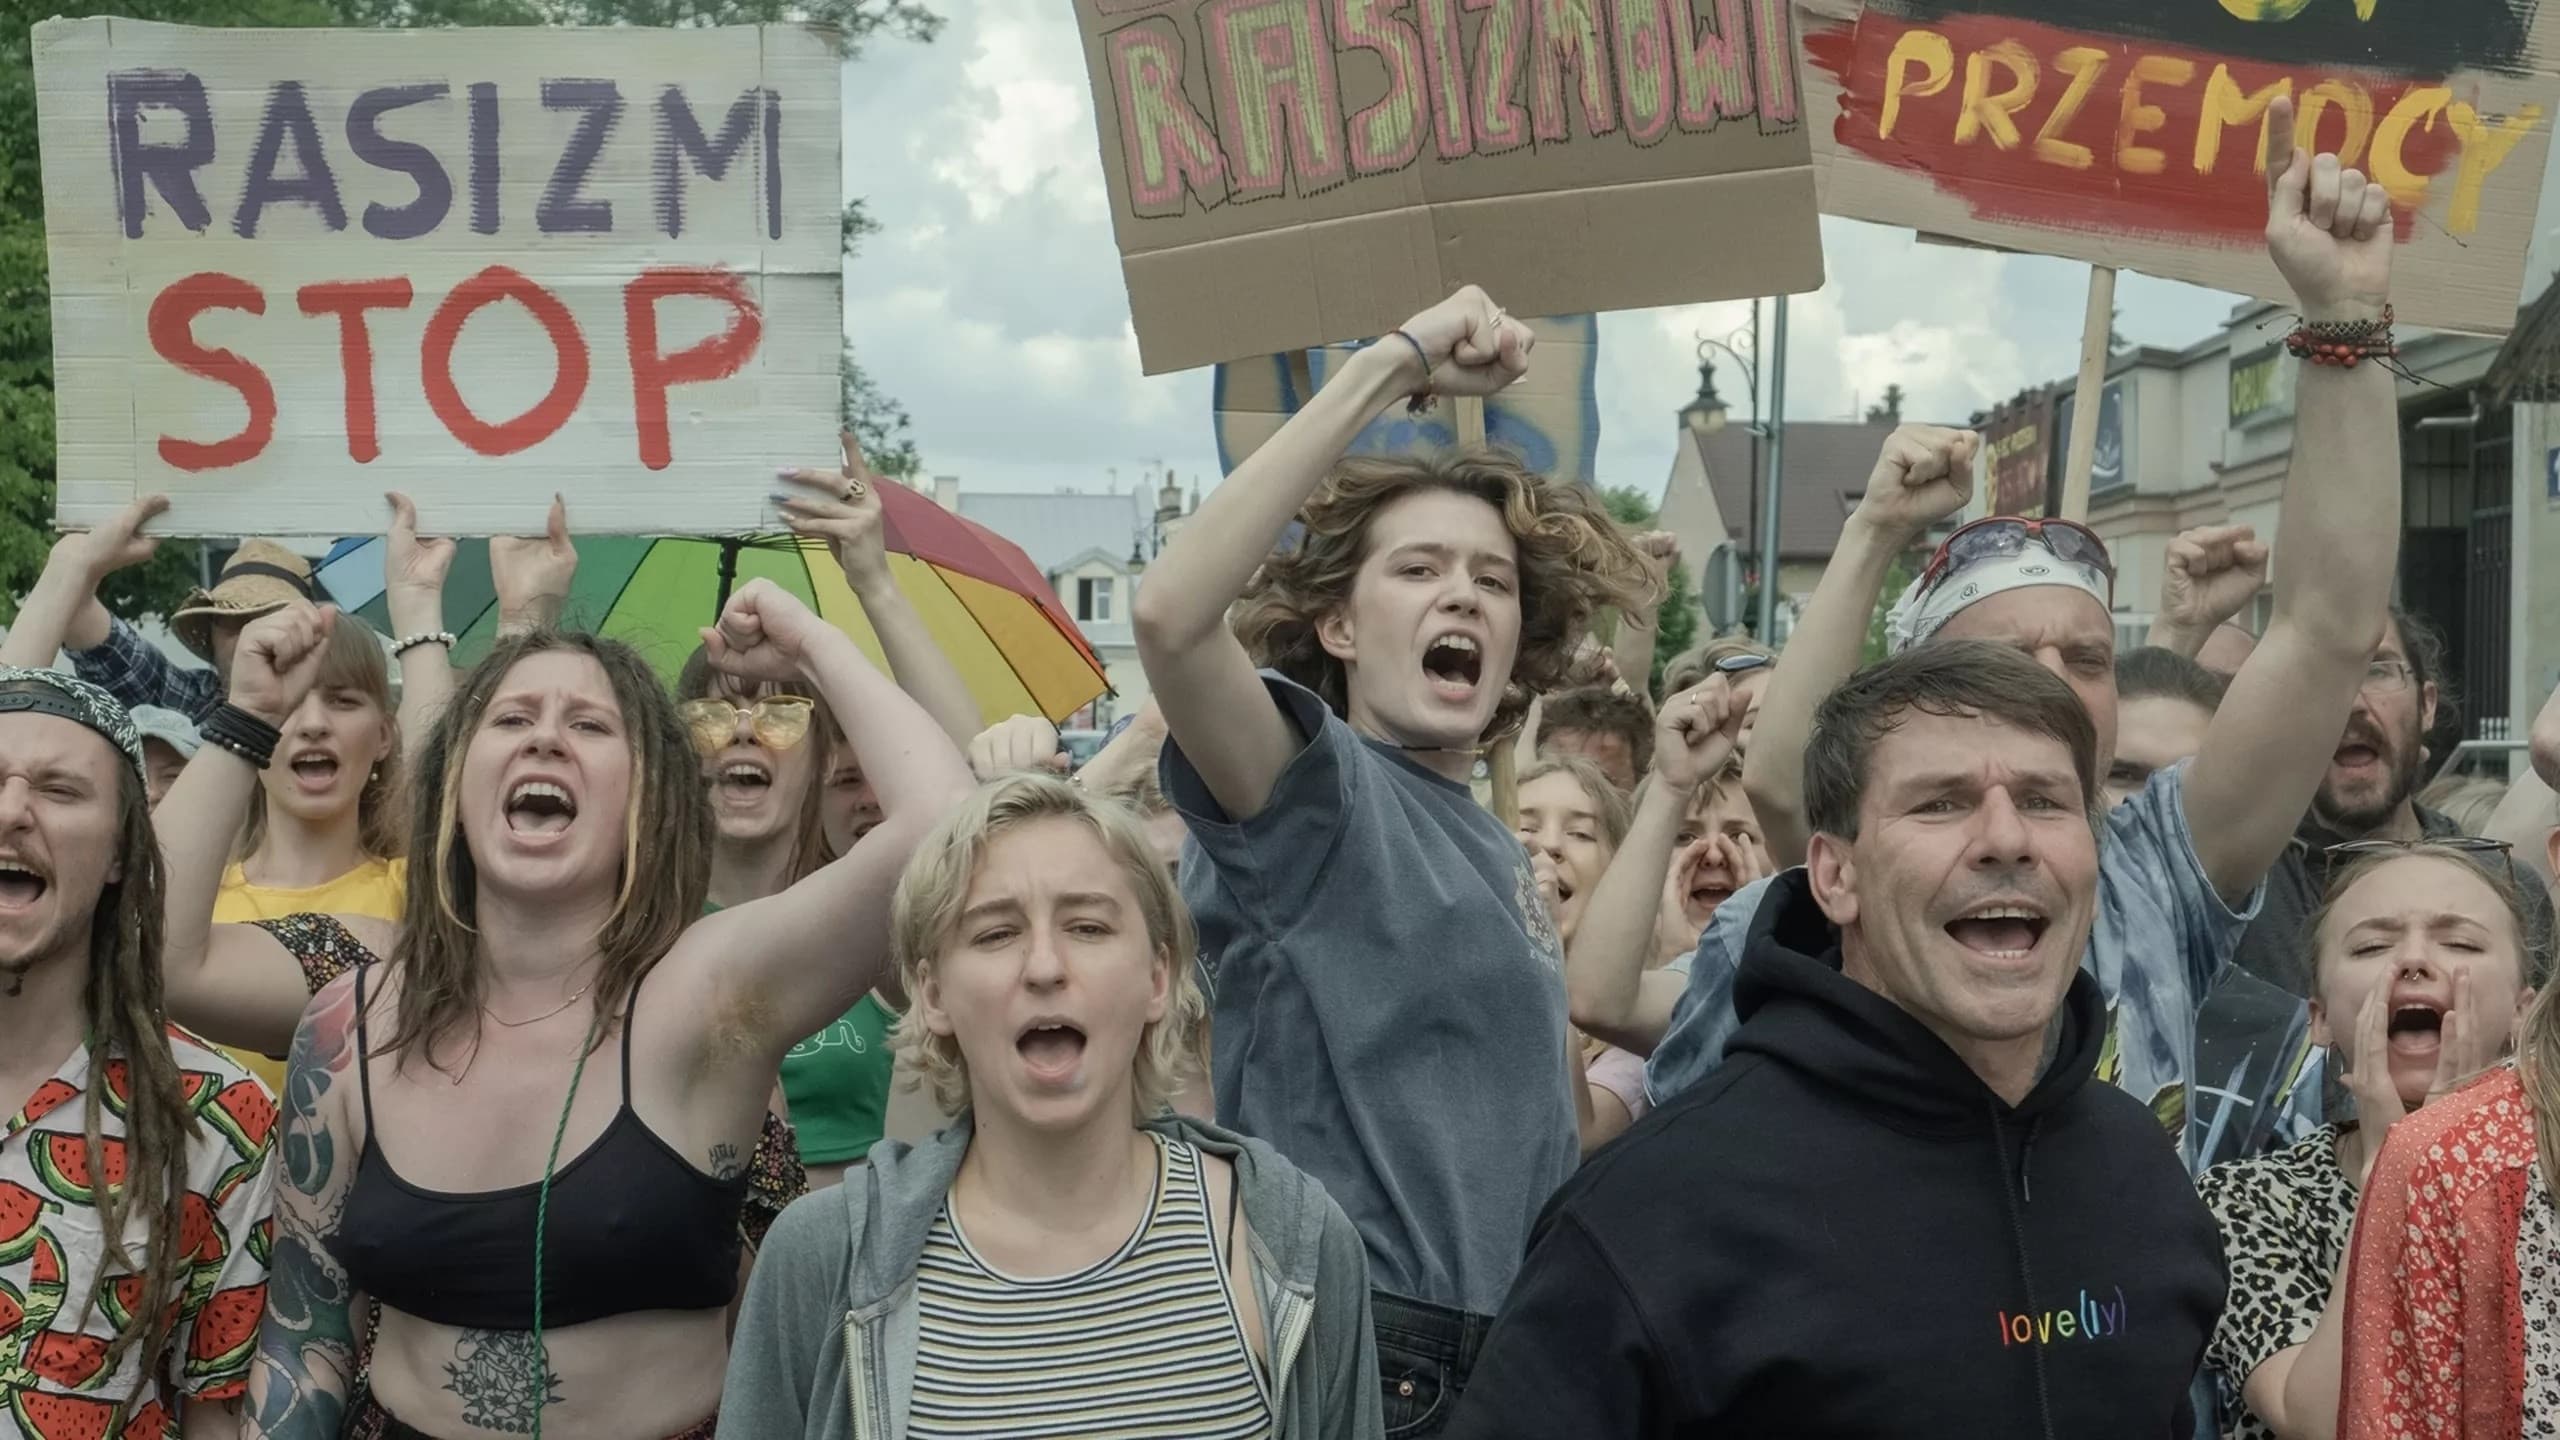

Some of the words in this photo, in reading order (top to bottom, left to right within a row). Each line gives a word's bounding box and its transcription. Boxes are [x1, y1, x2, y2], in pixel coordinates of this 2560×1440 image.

[107, 68, 782, 240] RASIZM
[1098, 0, 1798, 218] RASIZMOWI
[1879, 30, 2542, 232] PRZEMOCY
[148, 262, 763, 472] STOP
[1999, 1284, 2126, 1346] love(ly)
